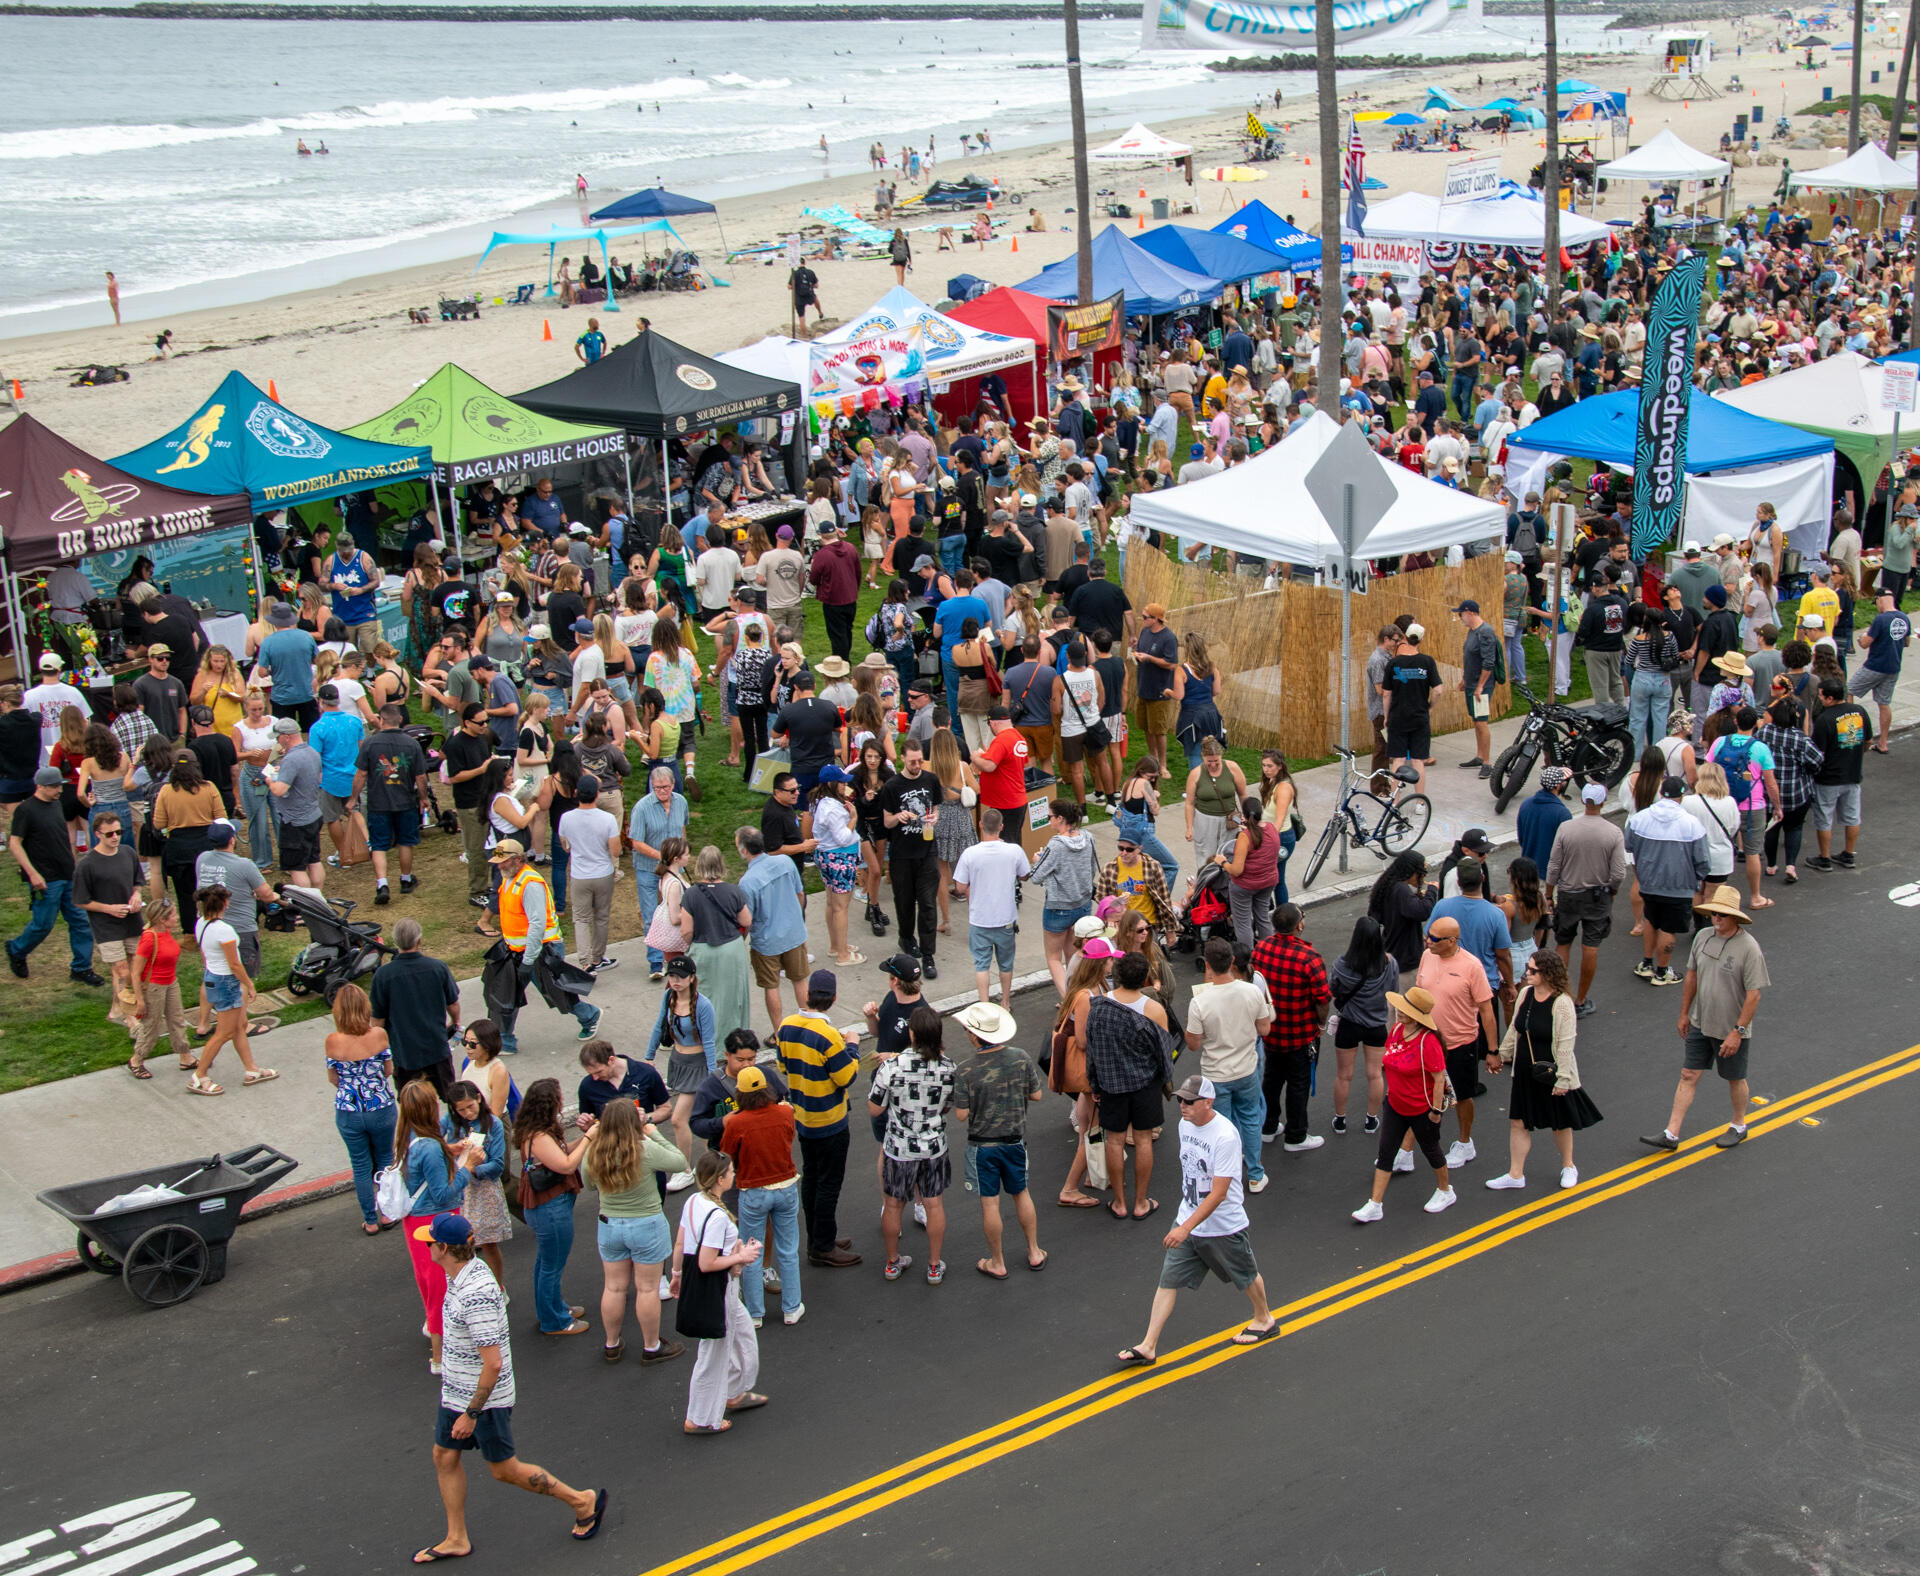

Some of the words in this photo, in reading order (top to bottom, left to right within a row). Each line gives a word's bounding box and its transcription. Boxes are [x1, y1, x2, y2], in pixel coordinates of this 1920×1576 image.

[1205, 2, 1284, 34] CHILI
[1447, 178, 1472, 196] SUNSET
[1275, 232, 1317, 248] OMBAC
[1344, 241, 1370, 260] HILI
[1373, 242, 1421, 265] CHAMPS
[824, 349, 849, 370] TACOS
[849, 338, 877, 358] TORTAS
[879, 338, 887, 352] &
[888, 339, 909, 354] MORE
[696, 403, 739, 422] SOURDOUGH
[744, 396, 768, 410] MOORE
[1654, 326, 1688, 504] weedmaps
[455, 455, 518, 483] RAGLAN
[522, 445, 574, 469] PUBLIC
[575, 434, 625, 457] HOUSE
[263, 456, 420, 500] WONDERLANDOB.COM
[57, 529, 88, 558] OB
[92, 517, 145, 551] SURF
[149, 505, 215, 540] LODGE
[627, 622, 654, 637] MARKET
[1071, 681, 1092, 690] FREE
